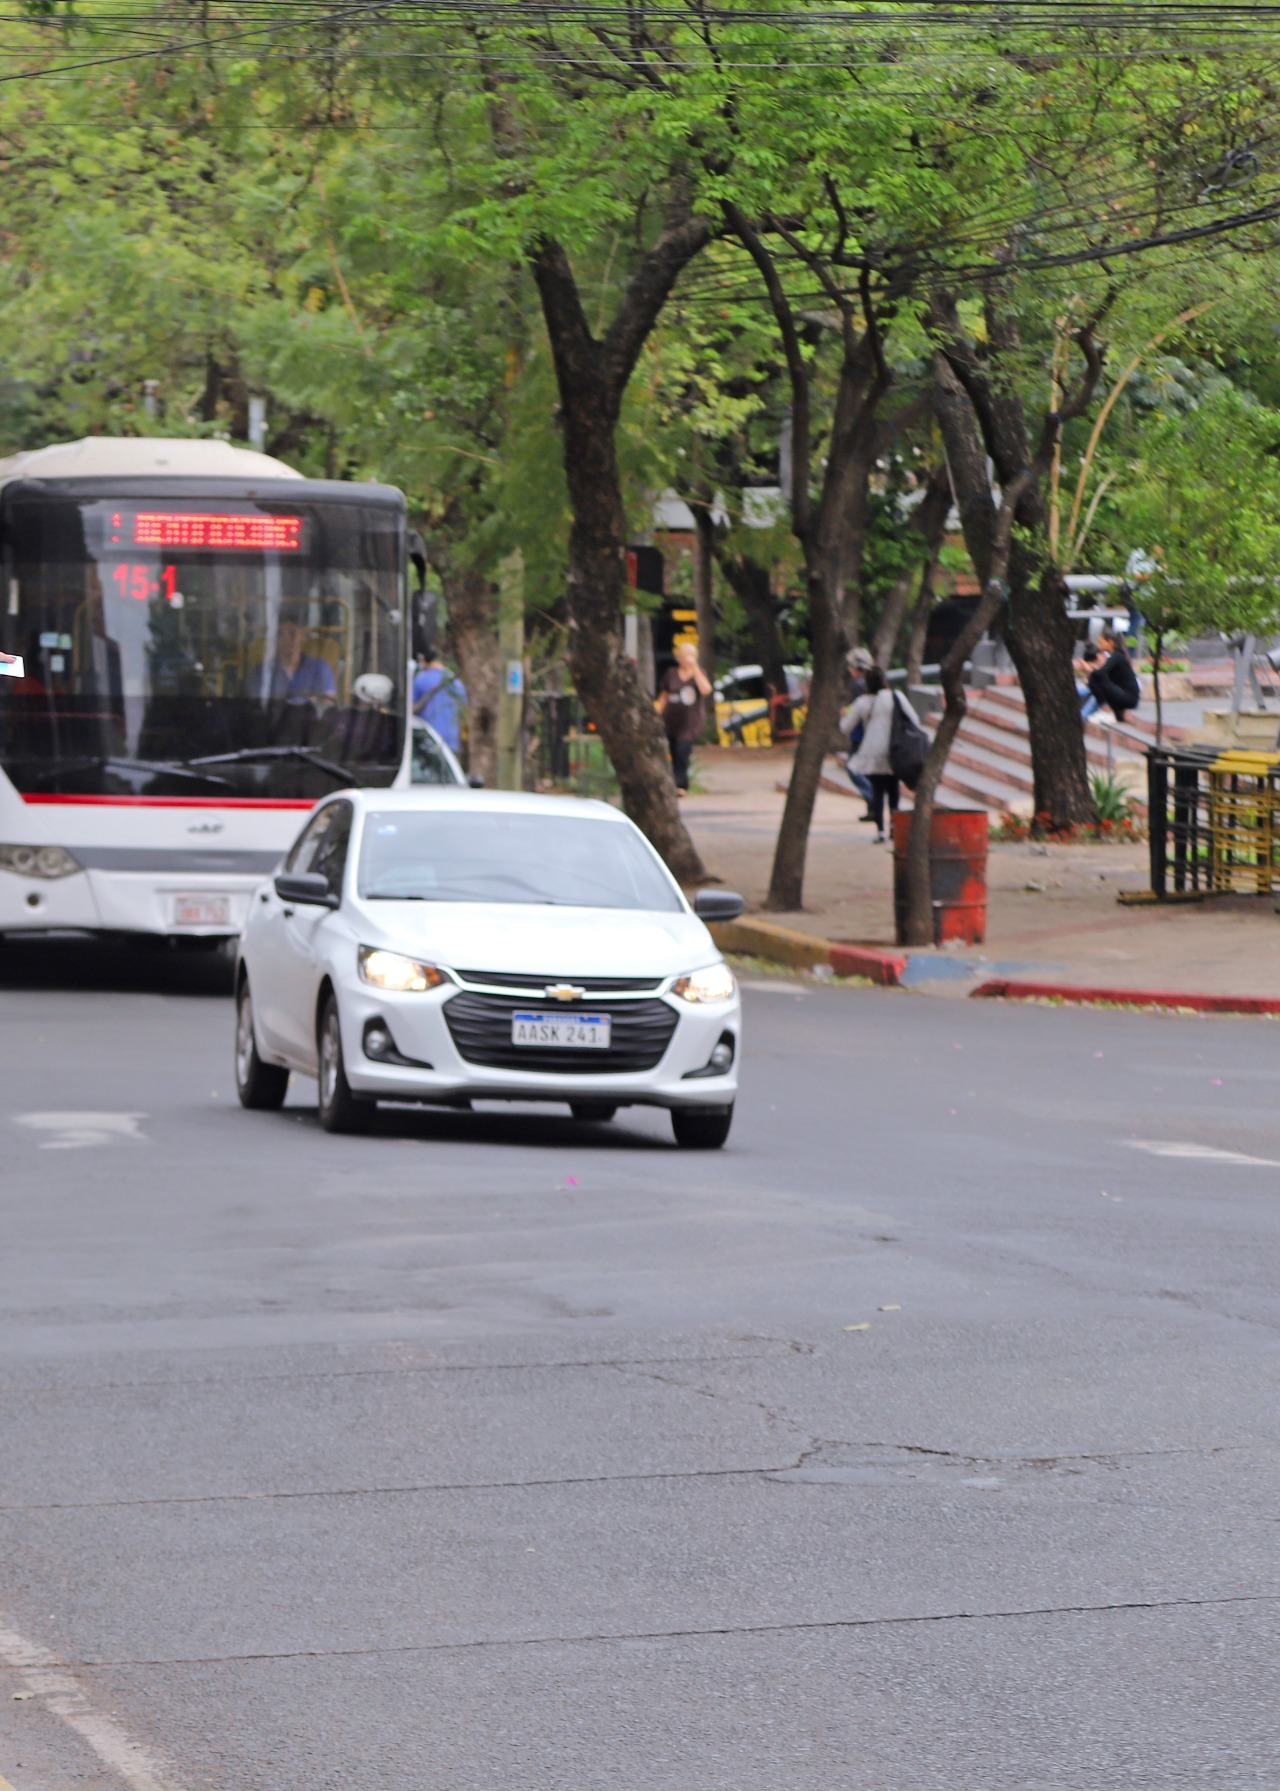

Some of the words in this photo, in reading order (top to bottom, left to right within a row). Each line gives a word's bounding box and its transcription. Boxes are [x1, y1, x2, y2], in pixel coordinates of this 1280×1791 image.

[113, 564, 176, 600] 15-1
[518, 1023, 560, 1041] AASK
[566, 1026, 597, 1043] 241
